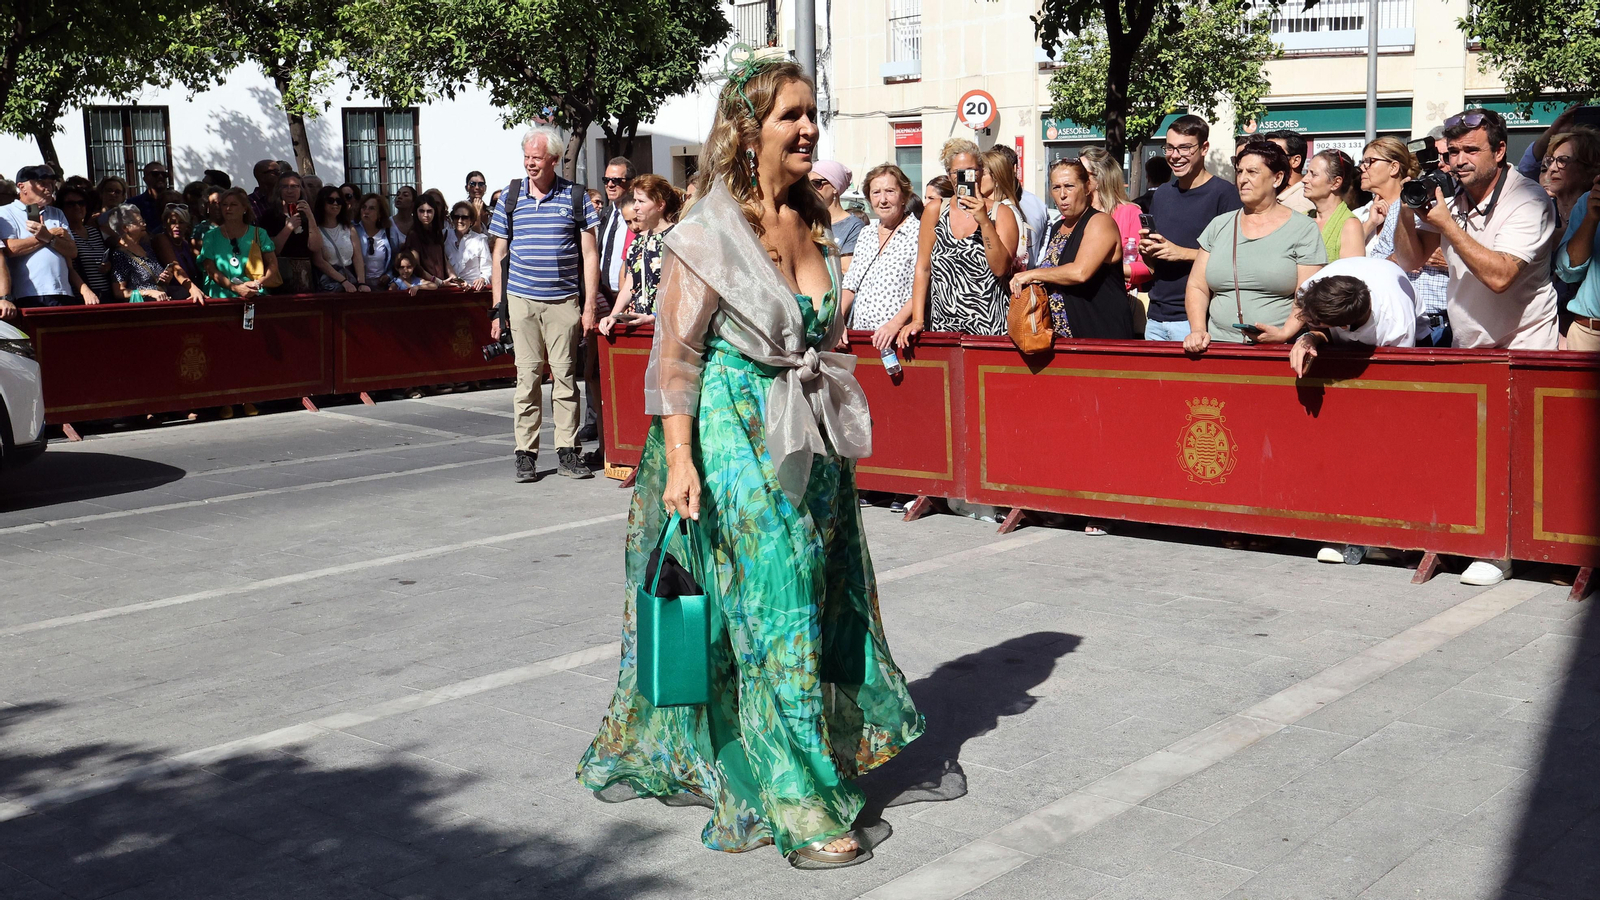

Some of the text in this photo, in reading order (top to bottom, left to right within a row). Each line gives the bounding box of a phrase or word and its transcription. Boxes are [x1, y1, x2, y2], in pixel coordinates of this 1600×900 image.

[966, 102, 988, 115] 20
[1259, 120, 1299, 129] ASESORES
[613, 469, 628, 478] PEPE
